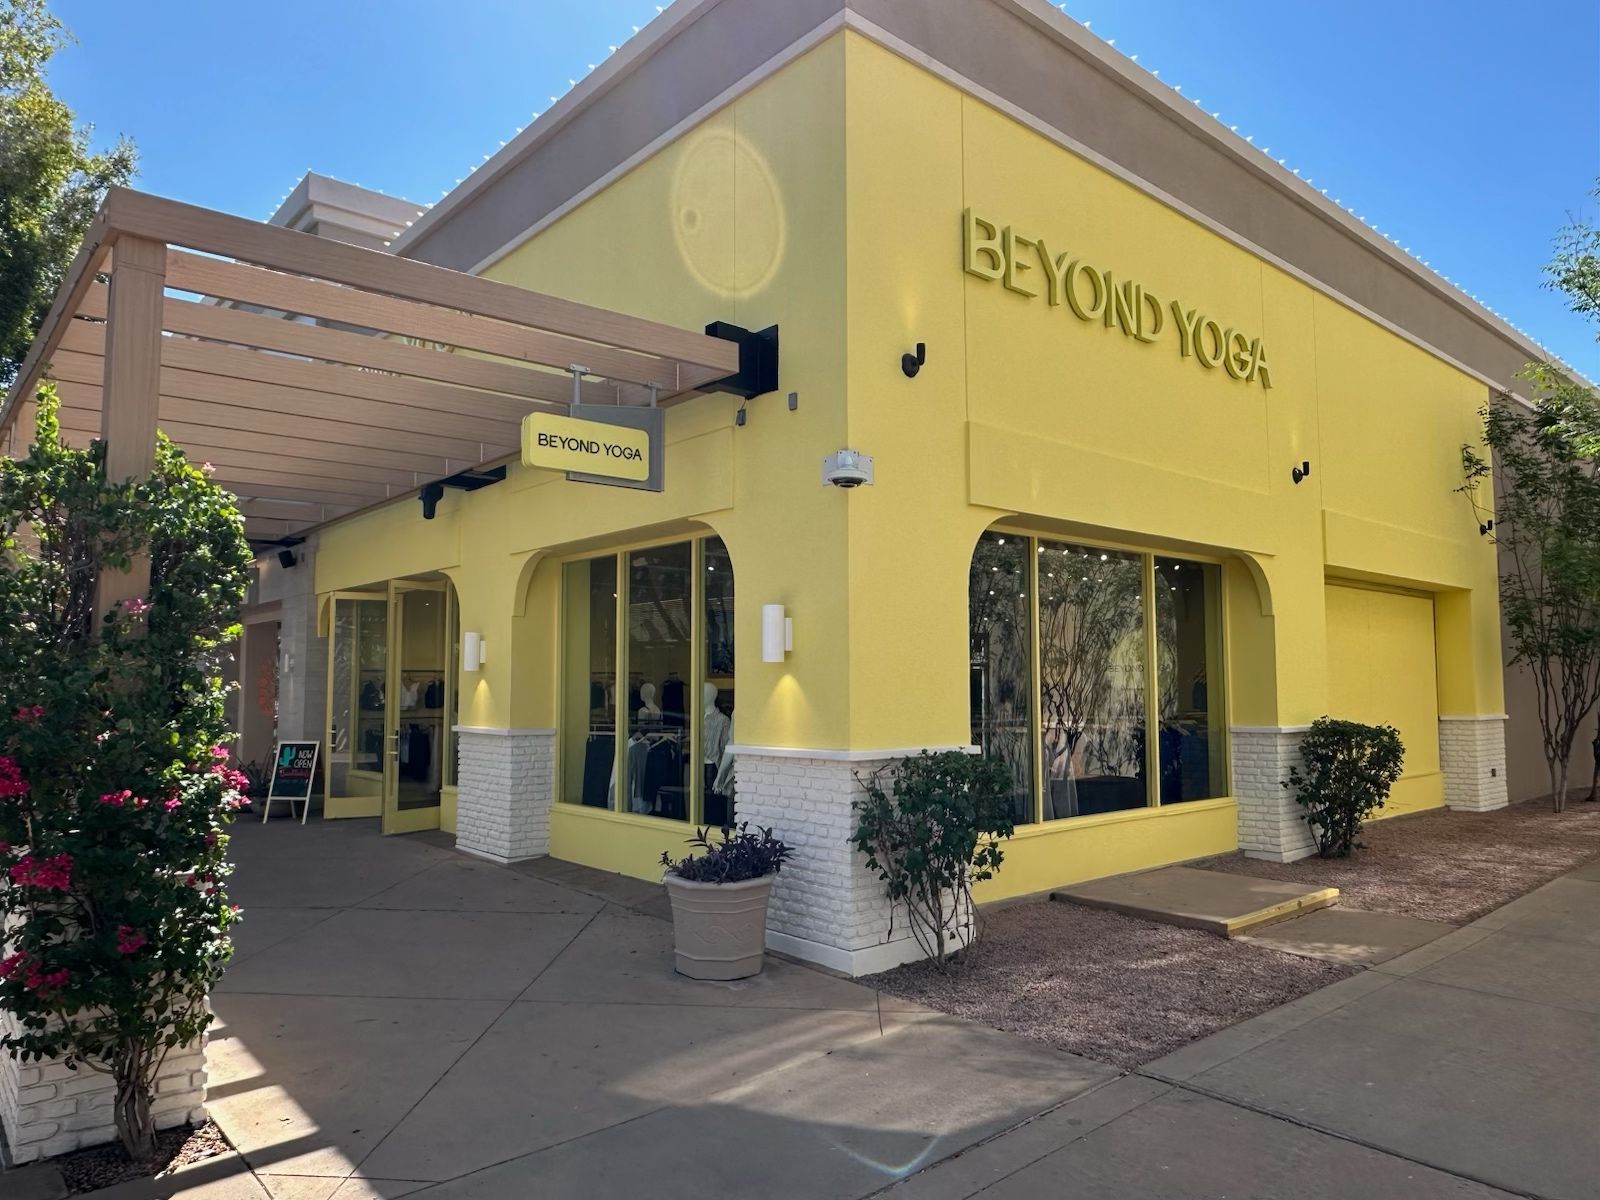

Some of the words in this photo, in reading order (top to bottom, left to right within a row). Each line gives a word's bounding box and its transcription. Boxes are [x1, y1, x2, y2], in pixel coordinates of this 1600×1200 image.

[963, 207, 1164, 344] BEYOND
[1170, 299, 1273, 389] YOGA
[538, 433, 600, 454] BEYOND
[603, 443, 643, 461] YOGA
[293, 759, 312, 768] OPEN
[298, 750, 313, 759] NOW
